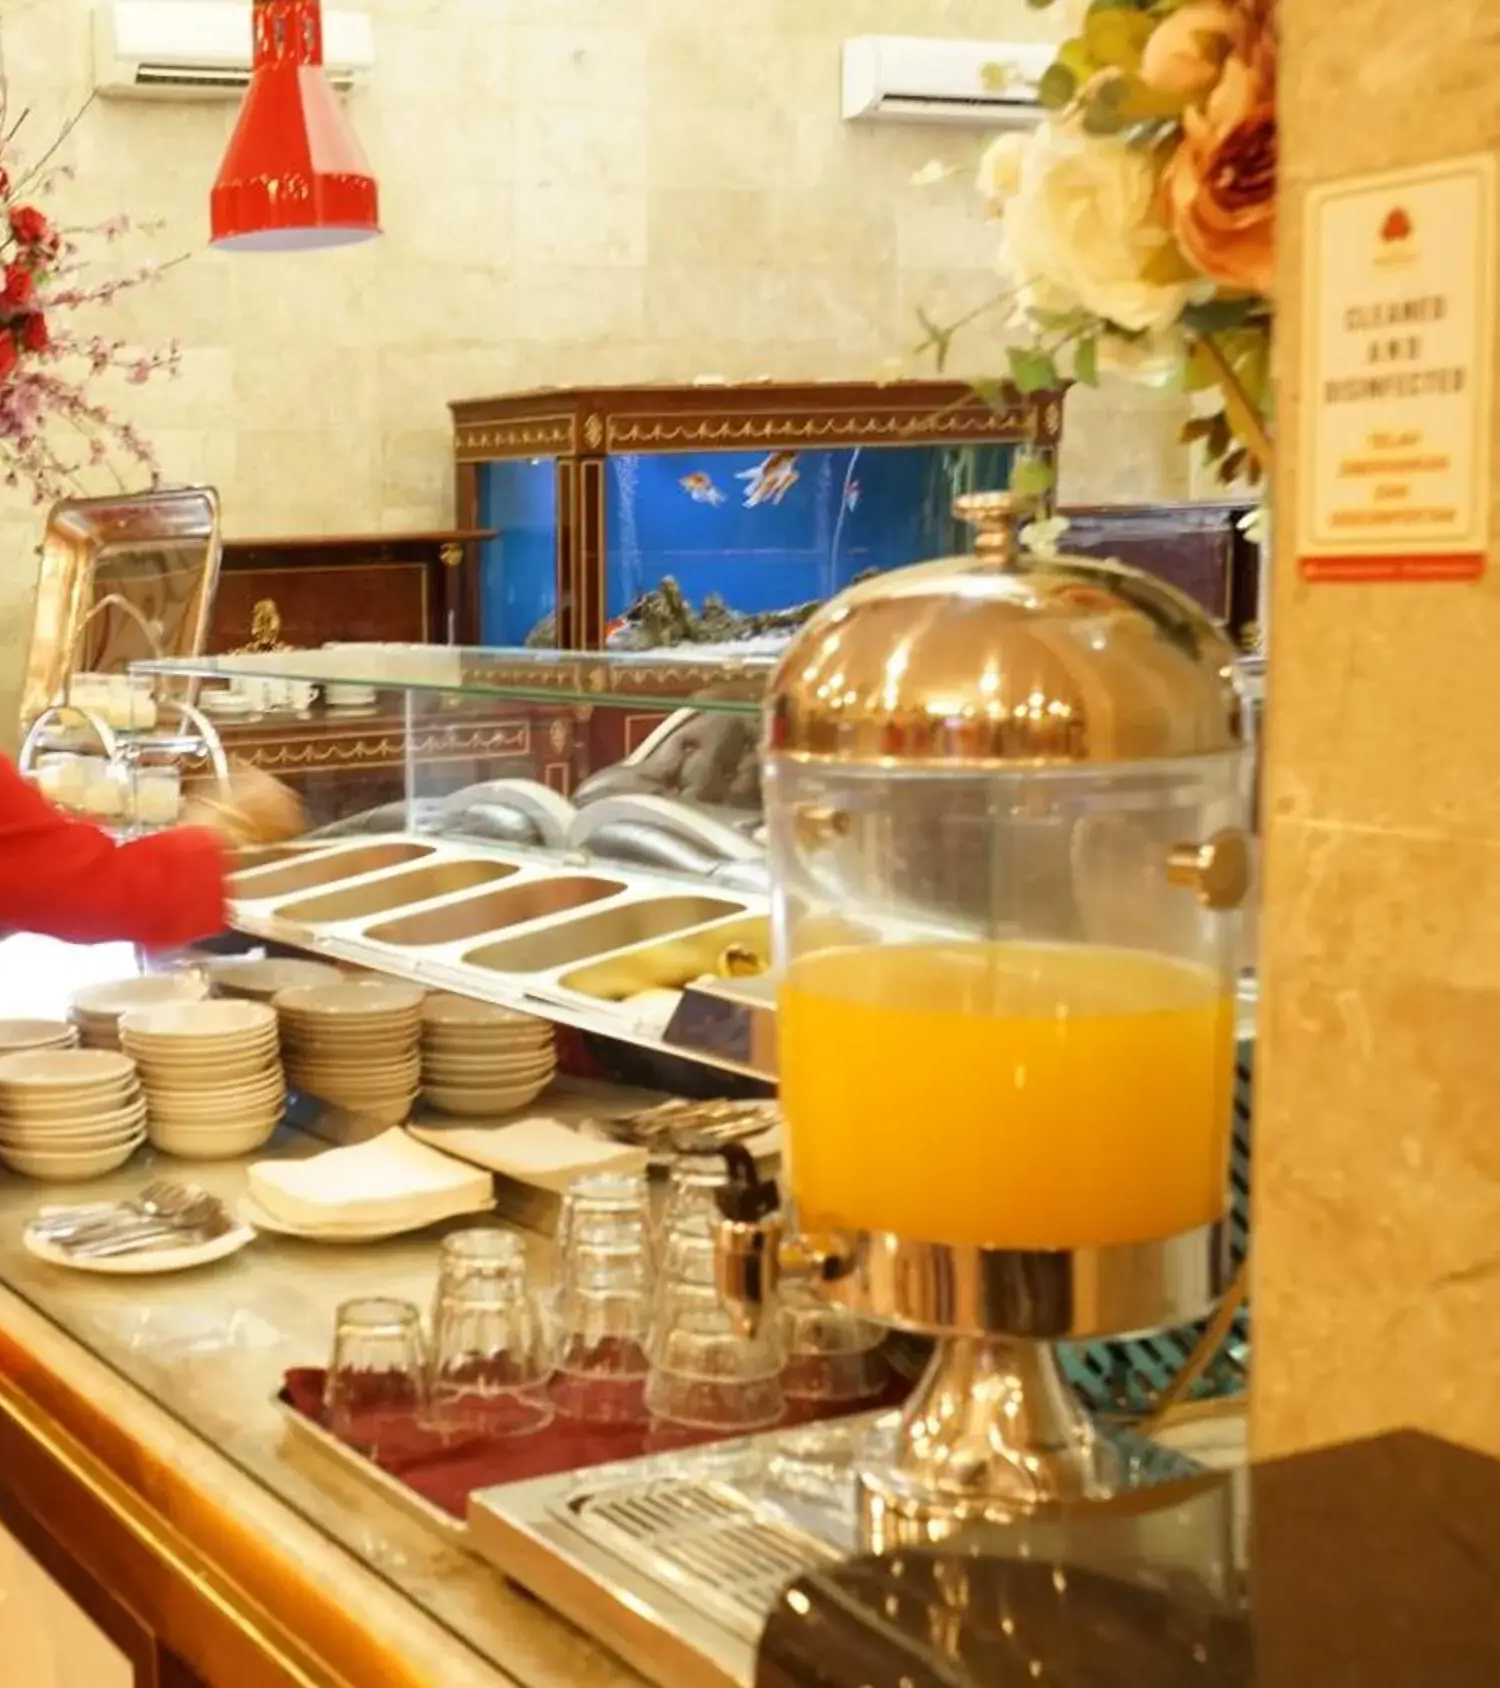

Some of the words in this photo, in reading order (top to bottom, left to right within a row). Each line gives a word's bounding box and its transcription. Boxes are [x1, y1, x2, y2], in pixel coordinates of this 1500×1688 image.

[1345, 296, 1447, 331] CLEANED
[1368, 336, 1422, 363] AND
[1325, 368, 1466, 403] DISINFECTED
